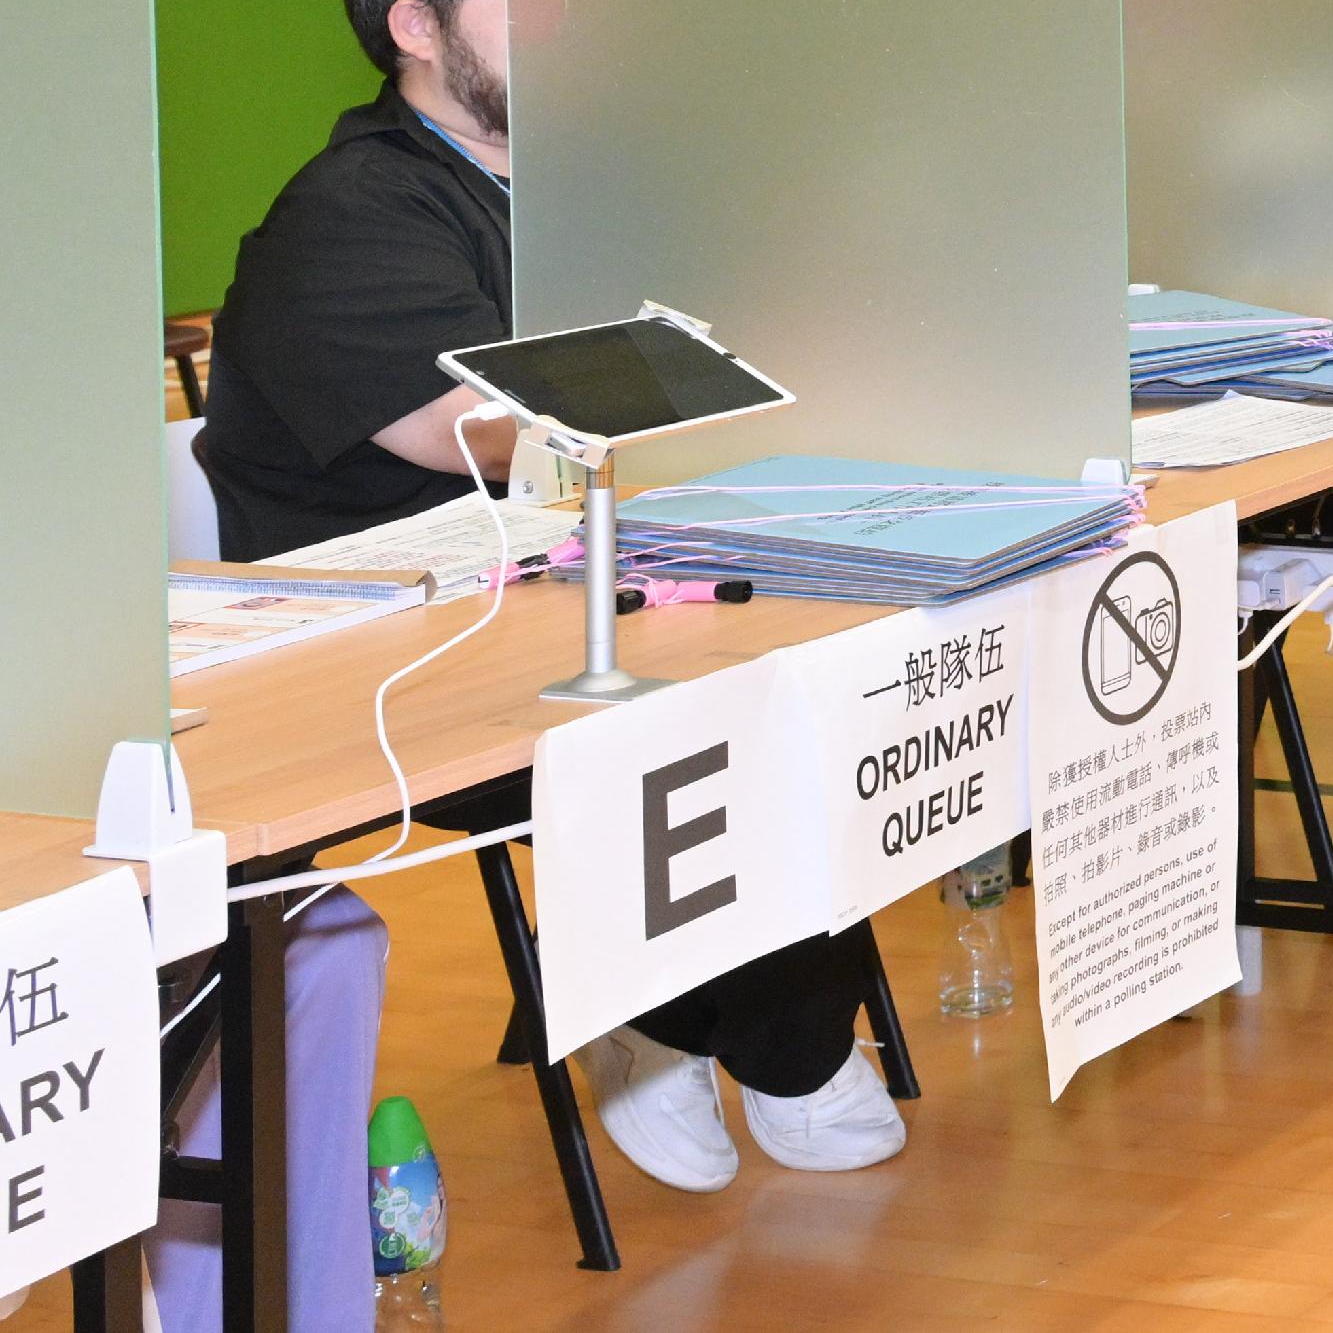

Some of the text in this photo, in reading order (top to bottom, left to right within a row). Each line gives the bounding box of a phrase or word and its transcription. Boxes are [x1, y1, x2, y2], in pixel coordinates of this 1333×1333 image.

[862, 624, 1005, 712] 一般隊伍
[856, 693, 1014, 801] ORDINARY
[642, 740, 737, 941] E
[882, 770, 984, 857] QUEUE
[1048, 837, 1218, 937] Except for authorized persons, use of
[1050, 862, 1216, 959] mobile telephone, paging machine or
[1060, 952, 1083, 972] other
[1085, 934, 1115, 957] device
[1117, 924, 1130, 938] for
[1132, 887, 1208, 933] communication,
[1210, 880, 1221, 892] or
[1062, 977, 1112, 1017] audio/video
[1113, 951, 1159, 983] recording
[1161, 943, 1170, 956] is
[1172, 919, 1219, 956] prohibited
[1070, 946, 1132, 989] photographs,
[1134, 926, 1169, 952] filming,
[1171, 919, 1181, 932] or
[1183, 900, 1218, 926] making
[1074, 961, 1184, 1028] within a polling station.
